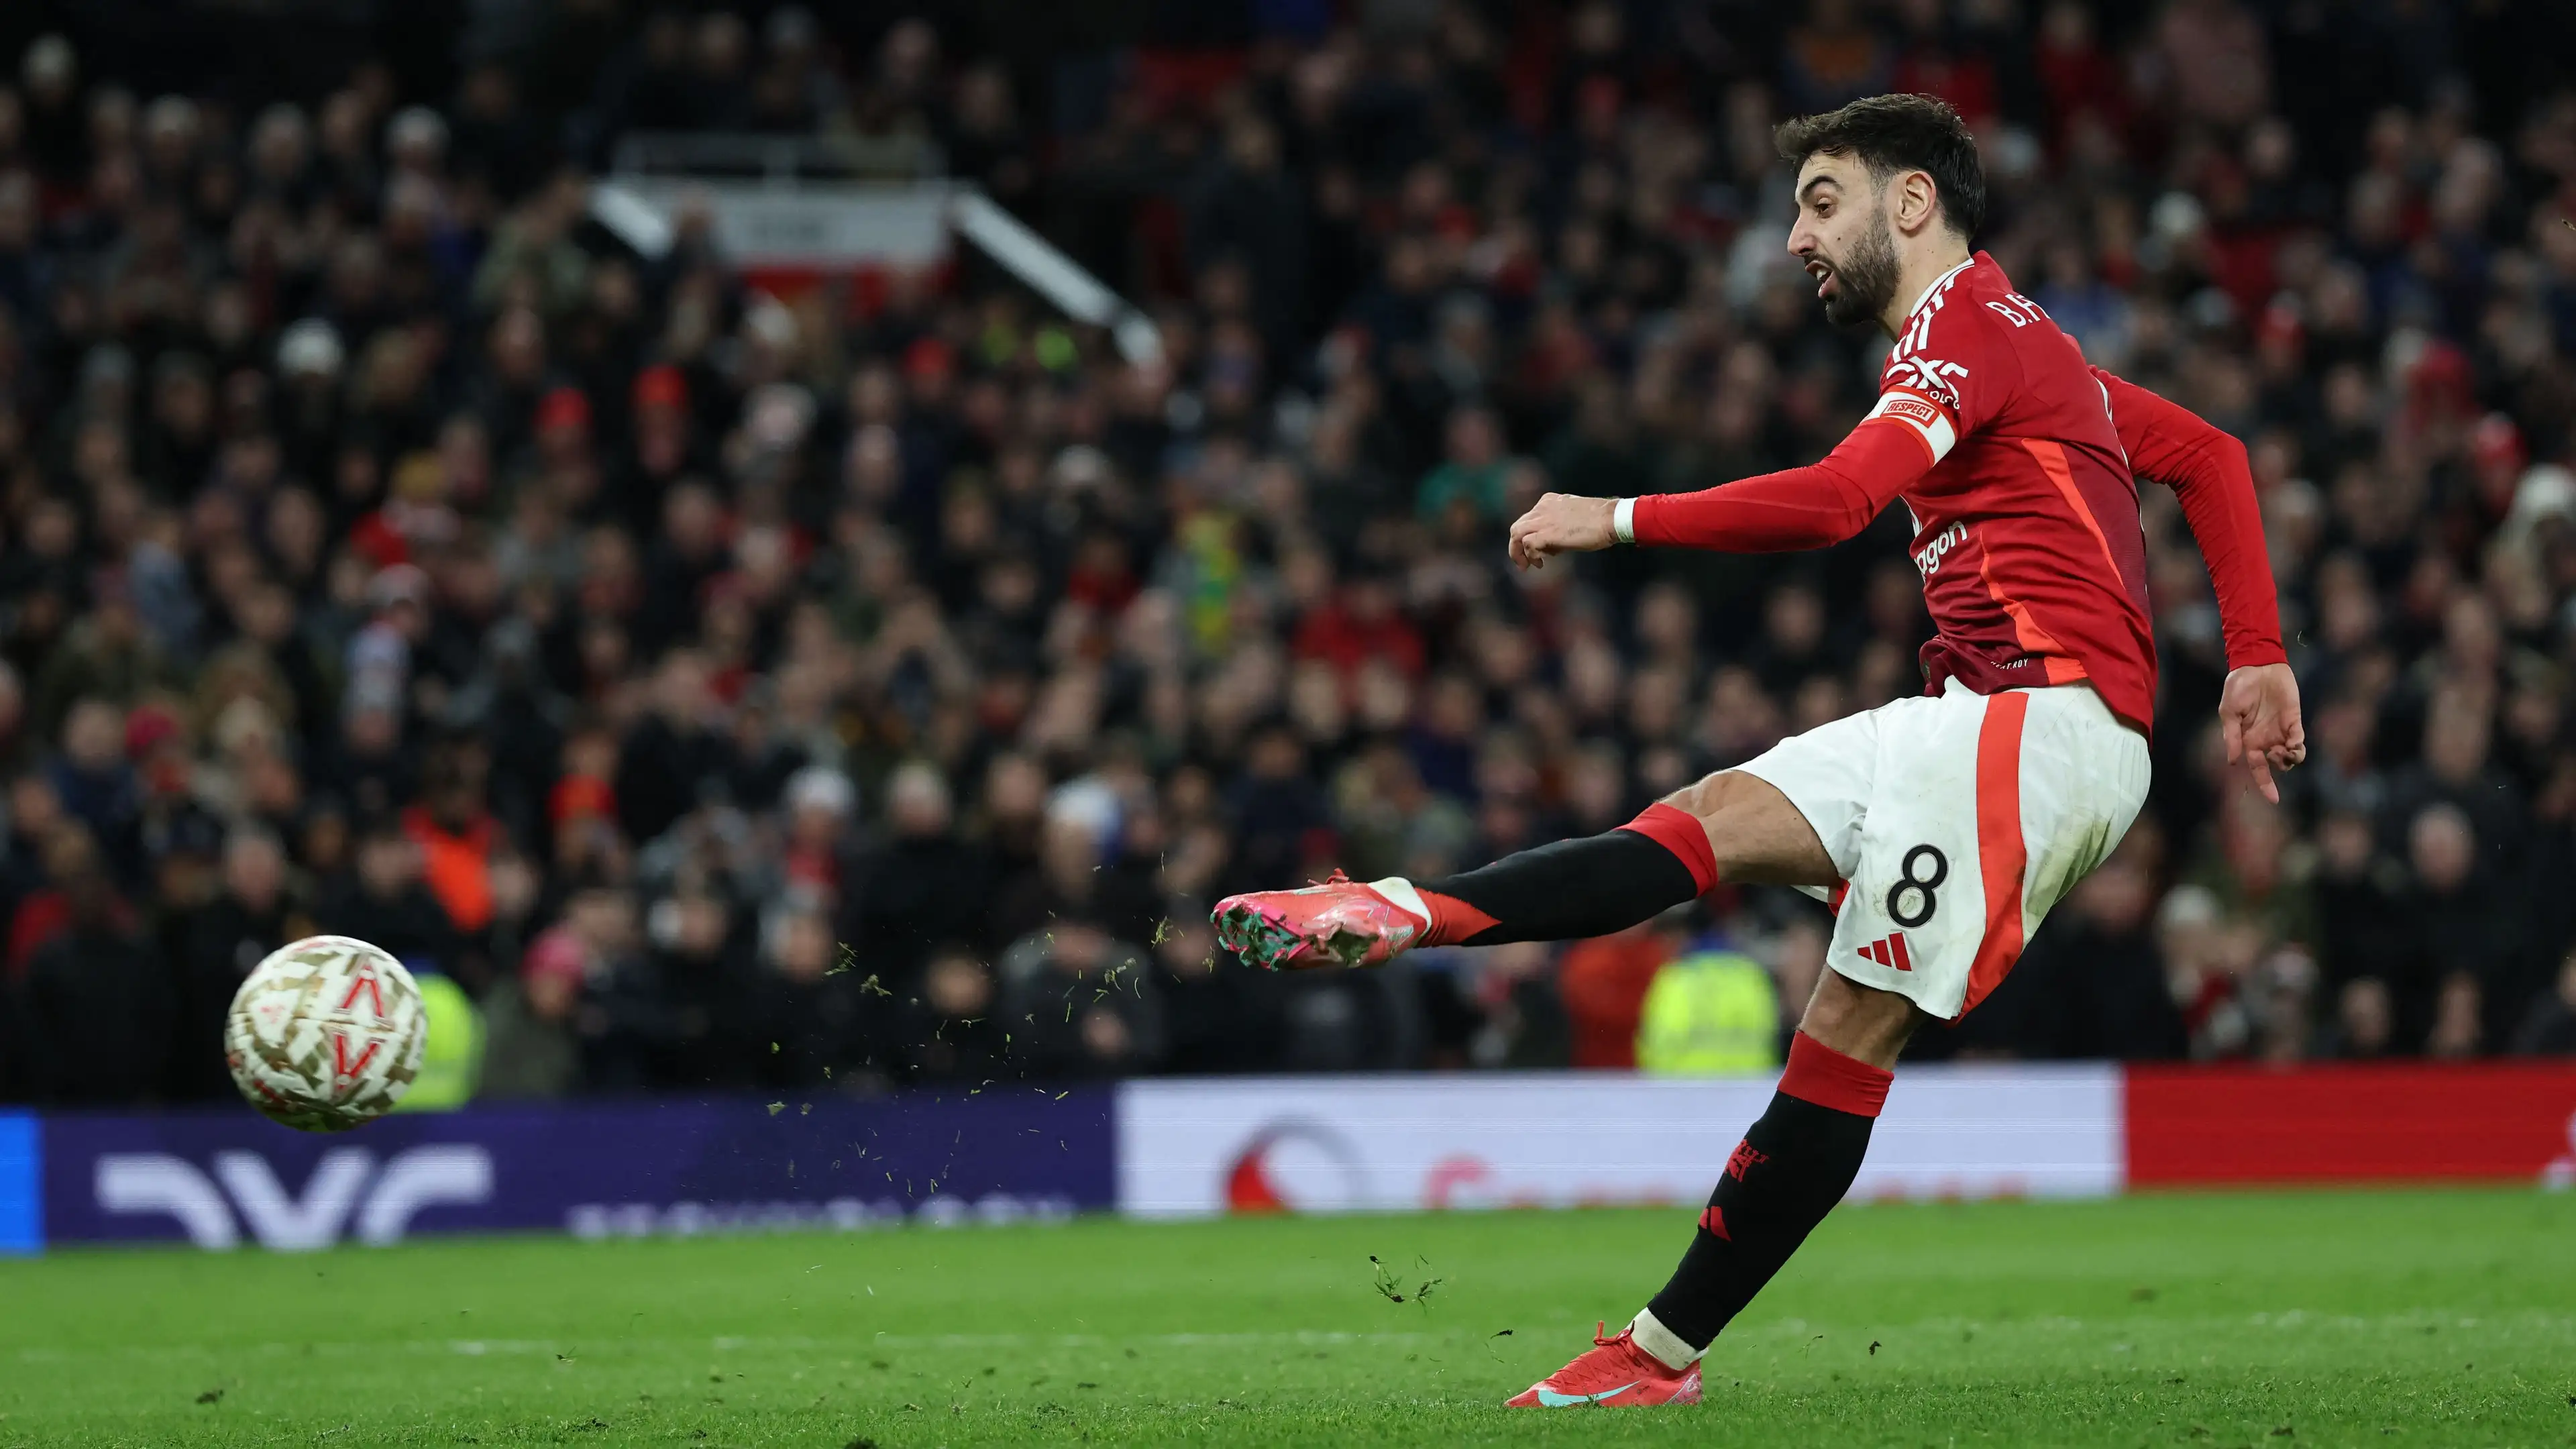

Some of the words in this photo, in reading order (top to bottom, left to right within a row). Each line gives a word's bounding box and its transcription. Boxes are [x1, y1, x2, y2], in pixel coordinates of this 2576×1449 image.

[1986, 293, 2051, 328] B.F
[1887, 402, 1932, 417] RESPECT
[1914, 521, 1967, 574] agon
[1885, 843, 1949, 929] 8
